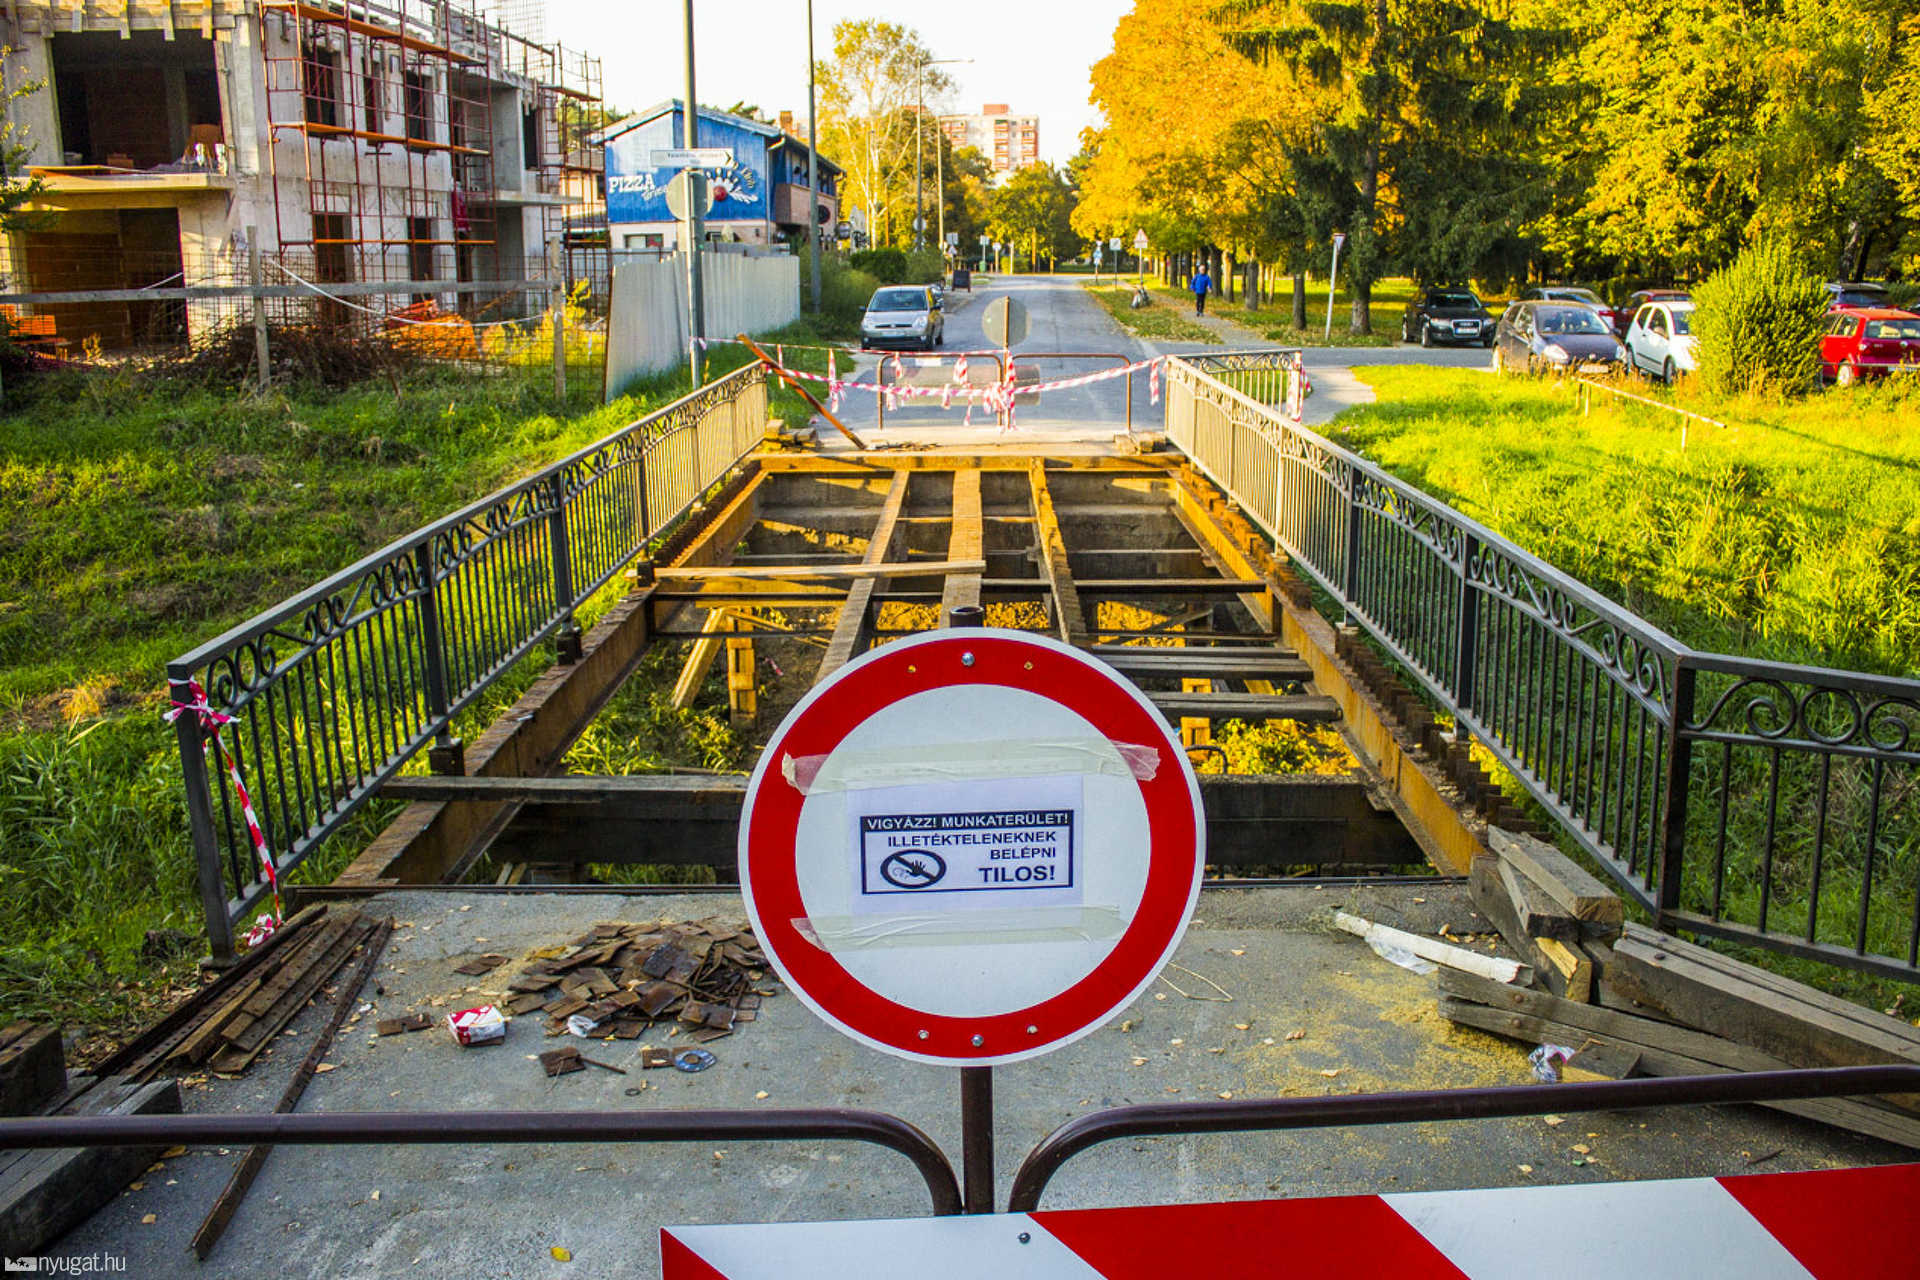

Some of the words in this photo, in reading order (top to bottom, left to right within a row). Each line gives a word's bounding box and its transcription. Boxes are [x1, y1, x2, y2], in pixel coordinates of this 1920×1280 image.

[608, 174, 655, 193] PIZZA
[867, 817, 937, 830] VIGYÁZZ!
[888, 831, 1056, 847] ILLETÉKTELENEKNEK
[990, 847, 1056, 860] BELÉPNI
[978, 866, 1055, 883] TILOS!
